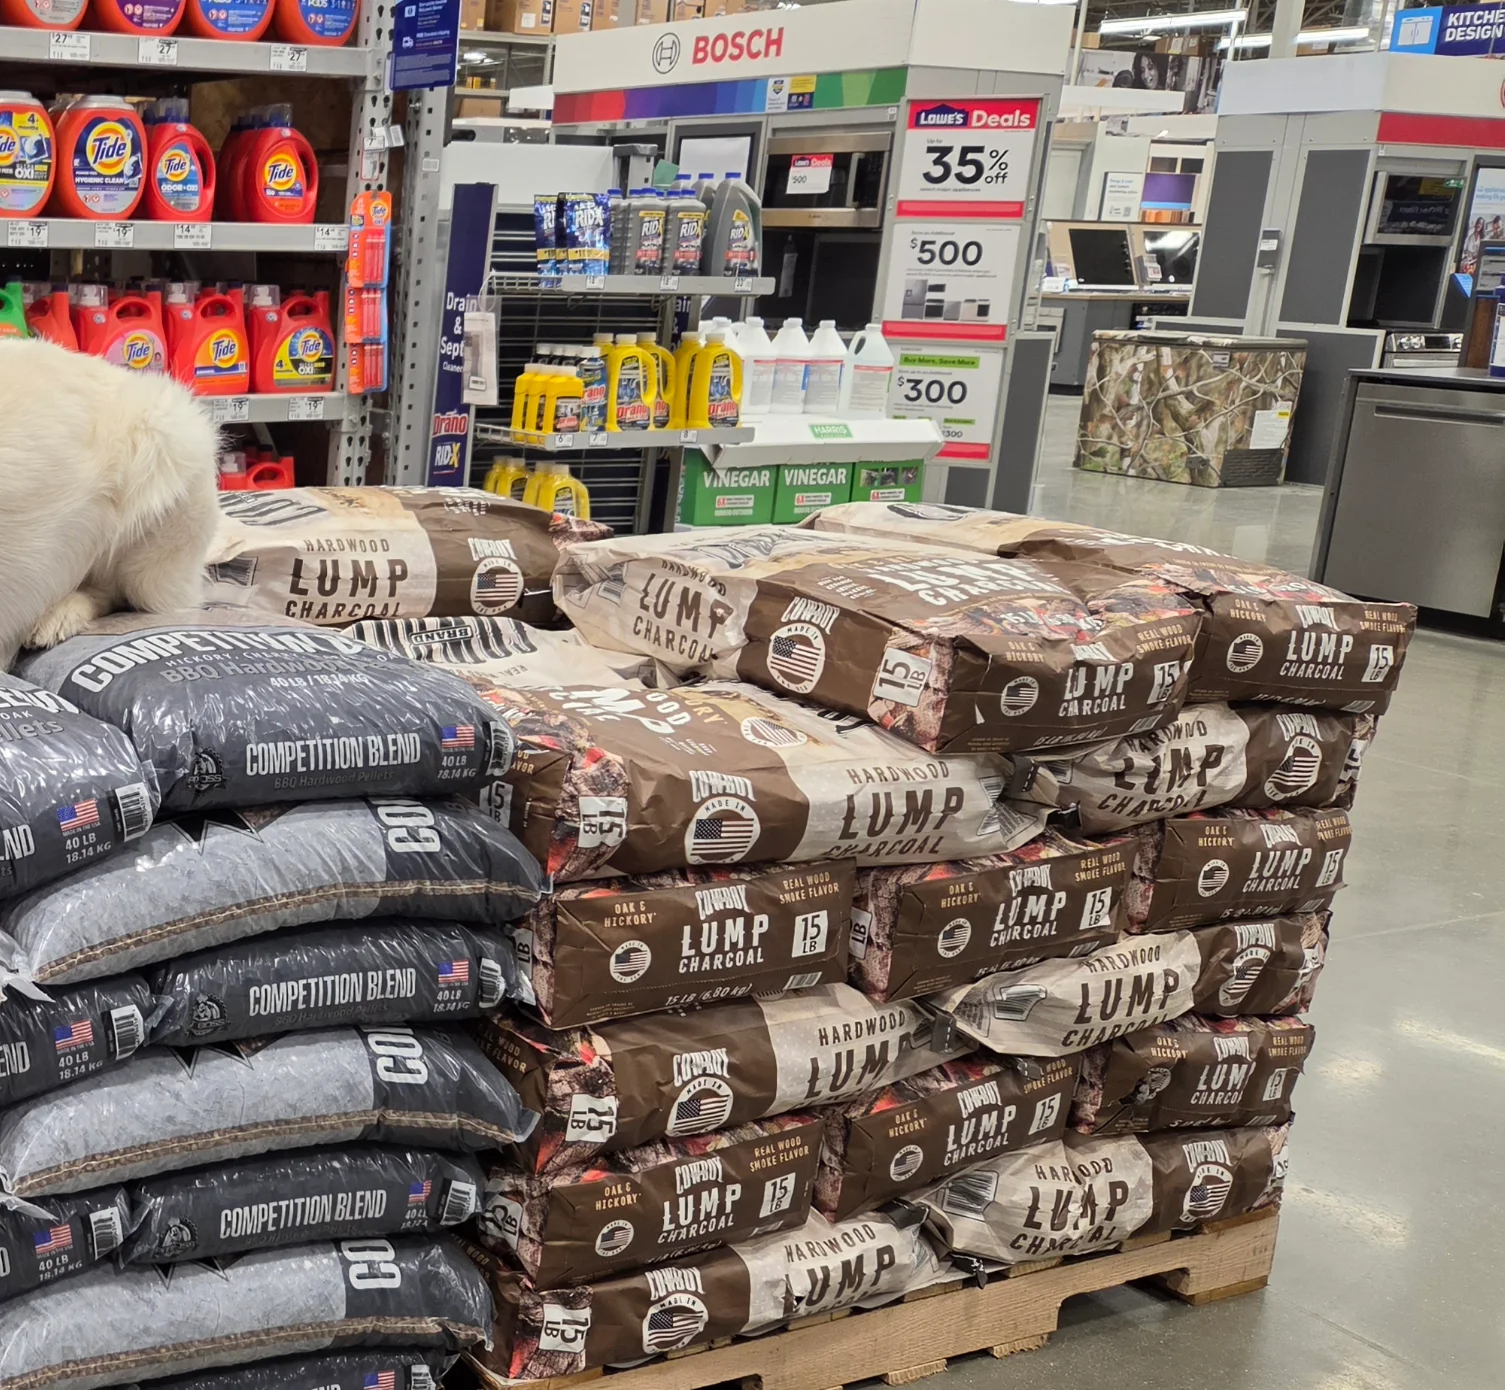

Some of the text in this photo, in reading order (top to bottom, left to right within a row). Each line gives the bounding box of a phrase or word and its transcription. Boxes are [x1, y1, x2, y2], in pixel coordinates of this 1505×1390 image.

[1445, 25, 1504, 42] DESIGN
[692, 27, 784, 65] BOSCH
[919, 110, 1030, 128] LOWE'S Deals
[164, 158, 187, 173] Tide
[811, 158, 832, 167] Deals
[75, 177, 105, 185] HYGIENIC
[984, 172, 1007, 184] off
[910, 237, 983, 266] $500
[447, 292, 478, 312] Drain
[453, 318, 462, 334] &
[127, 342, 149, 360] Tide
[212, 340, 236, 358] Tide
[441, 337, 464, 357] Sept
[897, 376, 968, 404] $300
[813, 426, 847, 435] HARRIS
[435, 443, 460, 467] RID-X
[703, 470, 770, 487] VINEGAR
[784, 468, 846, 486] VINEGAR
[305, 538, 390, 553] HARDWOOD
[1230, 609, 1267, 622] HICKORY
[414, 628, 469, 644] BRAND
[1138, 623, 1183, 642] REAL WOOD
[1280, 662, 1344, 680] CHARCOAL
[442, 755, 467, 768] 40 LB
[274, 771, 393, 789] BBQ Hardwood Pellets
[705, 798, 746, 811] MADE IN
[1198, 836, 1234, 847] HICKORY
[66, 841, 112, 863] 18.14 KG
[1080, 852, 1121, 869] REAL WOOD
[783, 872, 830, 890] REAL WOOD
[1075, 862, 1126, 882] SMOKE FLAVOR
[780, 882, 839, 904] SMOKE FLAVOR
[949, 884, 966, 894] OAK
[1243, 876, 1299, 893] CHARCOAL
[1090, 890, 1106, 915] 15
[604, 913, 654, 927] HICKORY
[681, 914, 769, 957] LUMP
[801, 940, 817, 954] LB
[249, 968, 416, 1017] COMPETITION BLEND
[665, 995, 680, 1006] 15
[682, 993, 696, 1003] LB
[818, 1009, 907, 1047] HARDWOOD
[58, 1051, 89, 1068] 40 LB
[672, 1048, 731, 1087] COWBOY
[59, 1060, 103, 1081] 18.14 KG
[686, 1079, 722, 1097] MADE IN
[1040, 1097, 1055, 1120] 15
[896, 1113, 911, 1125] OAK
[947, 1105, 1017, 1152] LUMP
[754, 1136, 801, 1159] REAL WOOD
[750, 1146, 810, 1172] SMOKE FLAVOR
[675, 1157, 723, 1195] COWBOY
[604, 1186, 622, 1198] OAK
[770, 1179, 788, 1201] 15
[220, 1189, 387, 1240] COMPETITION BLEND
[663, 1184, 741, 1231] LUMP
[768, 1202, 782, 1213] LB
[657, 1215, 734, 1245] CHARCOAL
